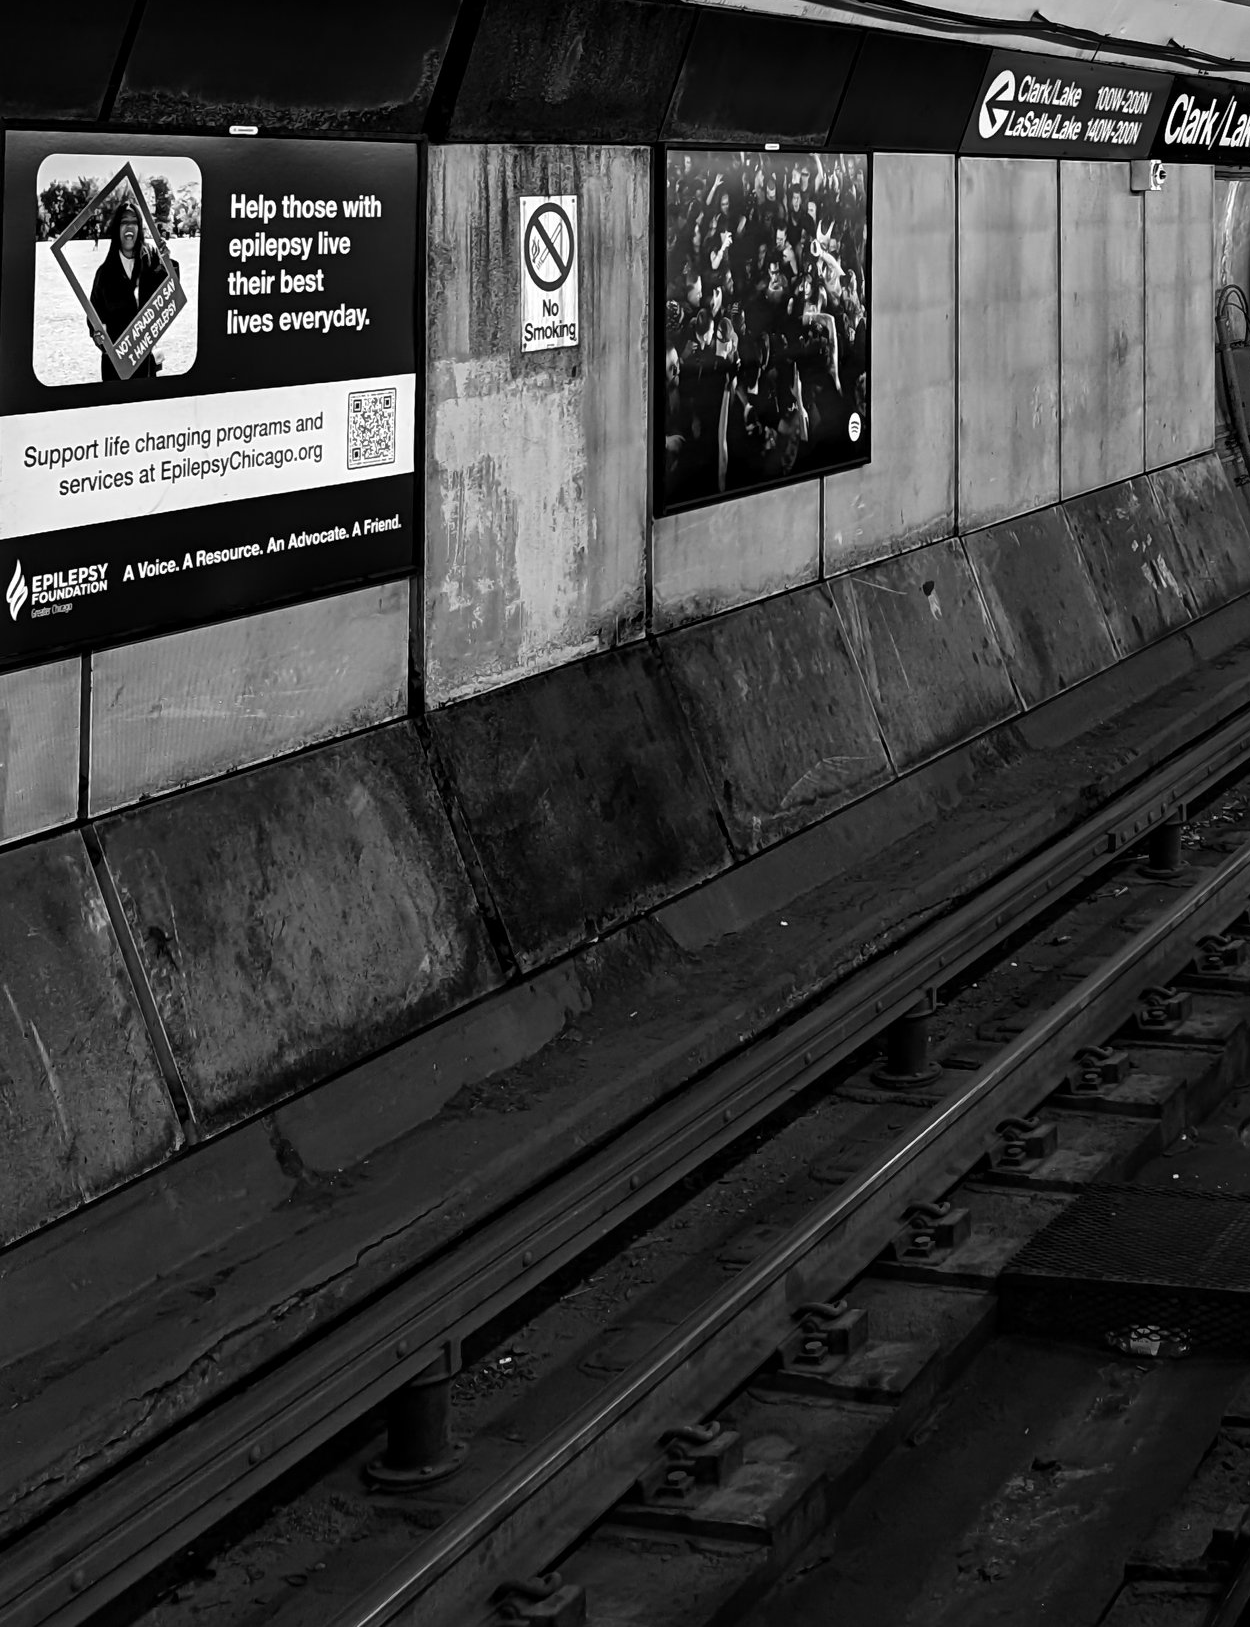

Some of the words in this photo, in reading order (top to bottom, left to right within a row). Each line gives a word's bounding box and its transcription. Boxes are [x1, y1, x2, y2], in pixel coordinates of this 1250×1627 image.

[1018, 75, 1082, 107] Clark/Lake
[1095, 87, 1152, 115] 100W-200N
[1004, 110, 1082, 140] LaSalle/Lake
[1083, 118, 1142, 145] 140W-200N
[230, 193, 277, 224] Help
[282, 195, 337, 218] those
[342, 195, 382, 218] with
[229, 233, 313, 261] epilepsy
[317, 232, 351, 255] live
[228, 271, 276, 295] their
[280, 269, 324, 293] best
[115, 335, 131, 359] NOT
[132, 309, 155, 340] AFRAID
[152, 295, 163, 311] TO
[163, 278, 175, 300] SAY
[227, 310, 274, 334] lives
[278, 304, 370, 335] everyday.
[543, 299, 559, 317] No
[134, 332, 153, 359] HAVE
[150, 300, 176, 338] EPILEPSY
[525, 320, 576, 341] Smoking
[23, 439, 99, 468] Support
[103, 435, 130, 457] life
[135, 426, 211, 455] changing
[216, 417, 292, 444] programs
[296, 412, 324, 431] and
[59, 470, 134, 495] services
[139, 464, 156, 483] at
[161, 443, 323, 482] EpilepsyChicago.org
[123, 565, 134, 582] A
[138, 559, 180, 579] Voice.
[182, 553, 193, 570] A
[196, 543, 263, 567] Resource.
[267, 538, 286, 554] An
[288, 526, 349, 551] Advocate.
[351, 521, 361, 538] A
[364, 514, 402, 534] Friend.
[31, 580, 107, 605] FOUNDATION
[32, 562, 108, 592] EPILEPSY
